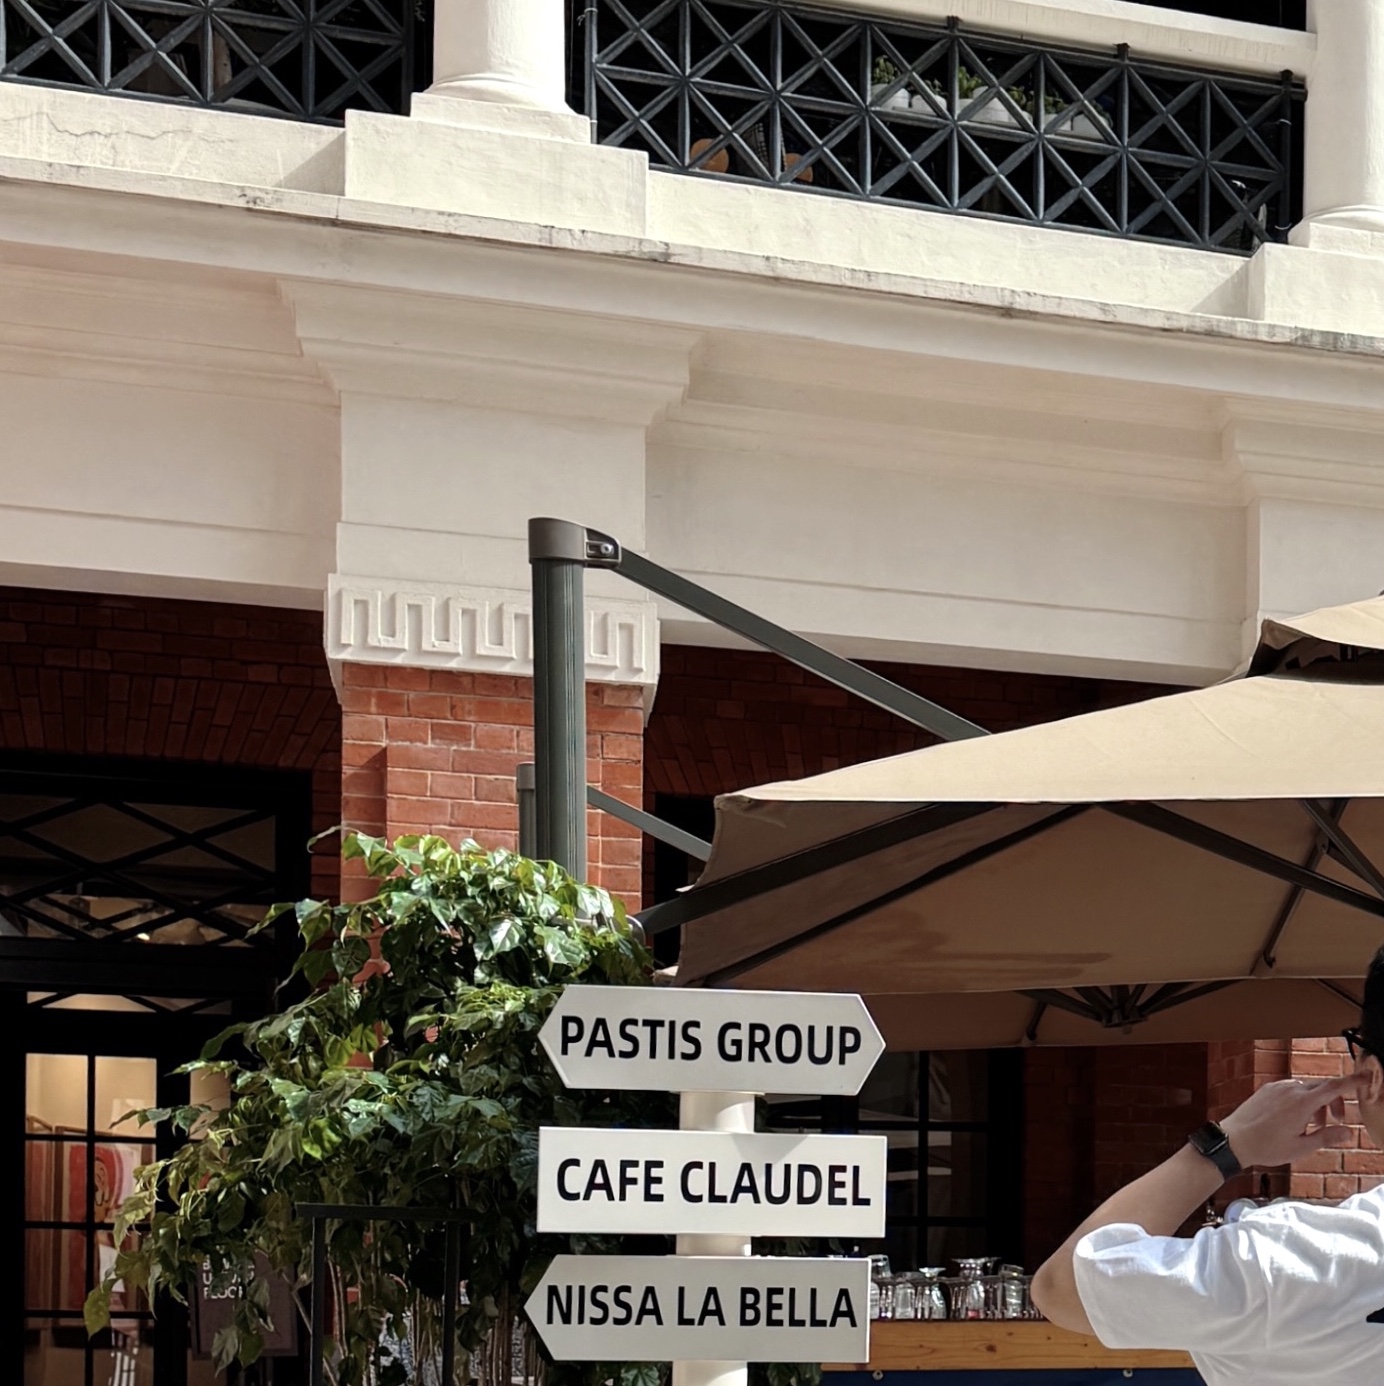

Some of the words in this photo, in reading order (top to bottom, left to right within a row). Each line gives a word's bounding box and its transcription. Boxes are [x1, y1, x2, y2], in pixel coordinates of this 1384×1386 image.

[560, 1015, 702, 1061] PASTIS
[717, 1021, 862, 1066] GROUP
[557, 1158, 664, 1202] CAFE
[680, 1160, 871, 1206] CLAUDEL
[546, 1284, 664, 1326] NISSA
[677, 1285, 726, 1327] LA
[739, 1286, 858, 1328] BELLA
